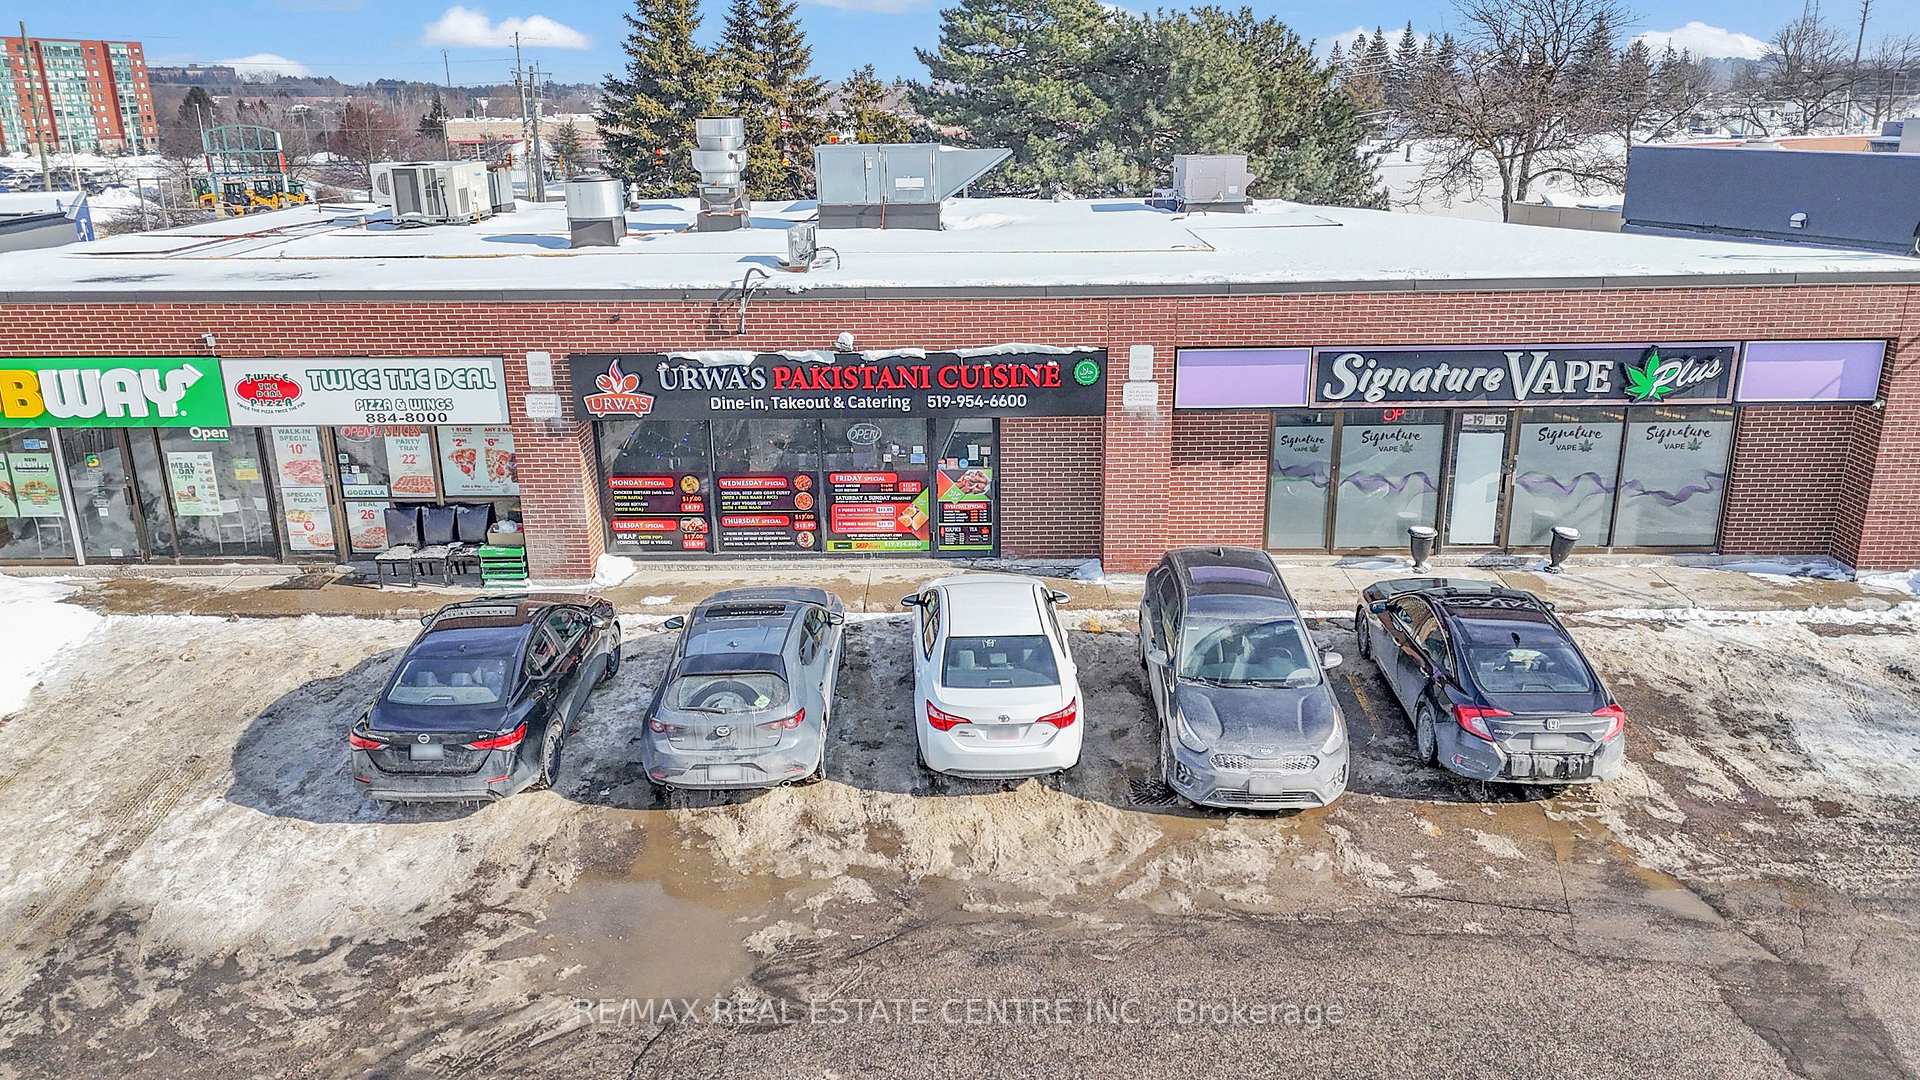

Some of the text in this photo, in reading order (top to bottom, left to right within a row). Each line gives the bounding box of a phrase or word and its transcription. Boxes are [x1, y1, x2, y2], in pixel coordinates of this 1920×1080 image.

[306, 368, 496, 391] TWICE THE DEAL
[657, 365, 1061, 390] URWA'S PAKISTANI CUISINE
[1322, 351, 1723, 402] Signature VAPE Plus
[0, 363, 204, 418] BWAY
[257, 383, 278, 391] THE
[249, 398, 293, 407] PIZZA
[355, 398, 454, 412] PIZZA & WINGS
[591, 397, 649, 411] URWA'S
[710, 394, 1027, 412] Dine-in, Takeout & Catering 519-954-6600
[366, 413, 448, 423] 884-8000
[189, 426, 229, 441] Open
[850, 428, 879, 440] OPEN
[1361, 427, 1422, 447] Signature
[1538, 425, 1603, 445] Signature
[1646, 423, 1712, 445] Signature
[1281, 434, 1325, 448] Signature
[1556, 443, 1578, 451] VAPE
[1663, 442, 1686, 450] VAPE
